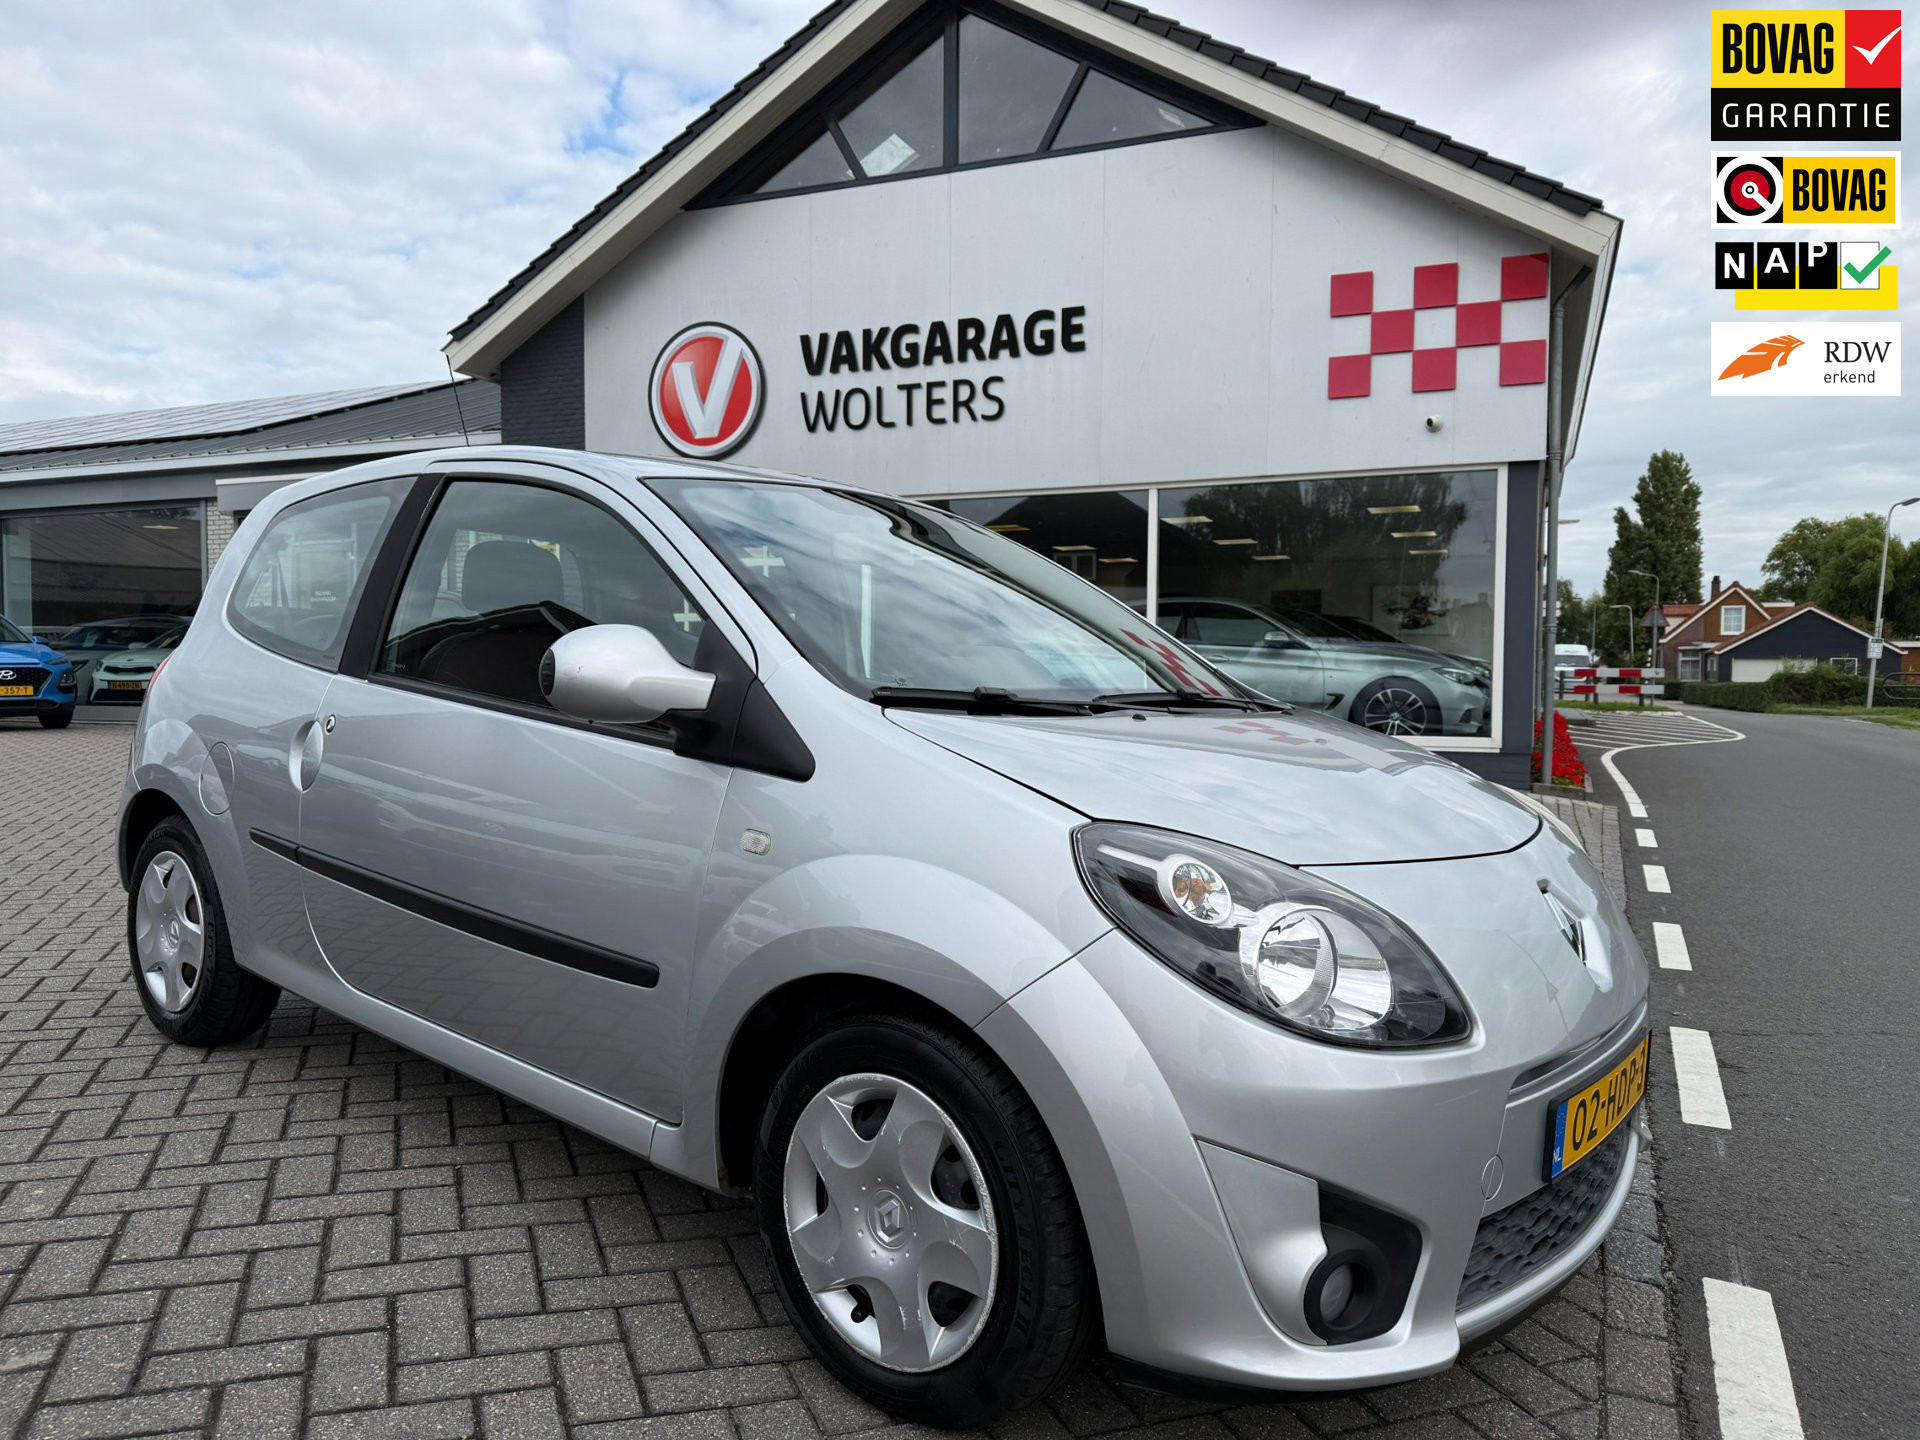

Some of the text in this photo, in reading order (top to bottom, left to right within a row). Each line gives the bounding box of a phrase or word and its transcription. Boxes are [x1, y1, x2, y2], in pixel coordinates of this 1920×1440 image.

[800, 306, 1086, 376] VAKGARAGE
[671, 334, 744, 439] V
[800, 376, 1005, 433] WOLTERS
[1552, 1146, 1562, 1166] NL
